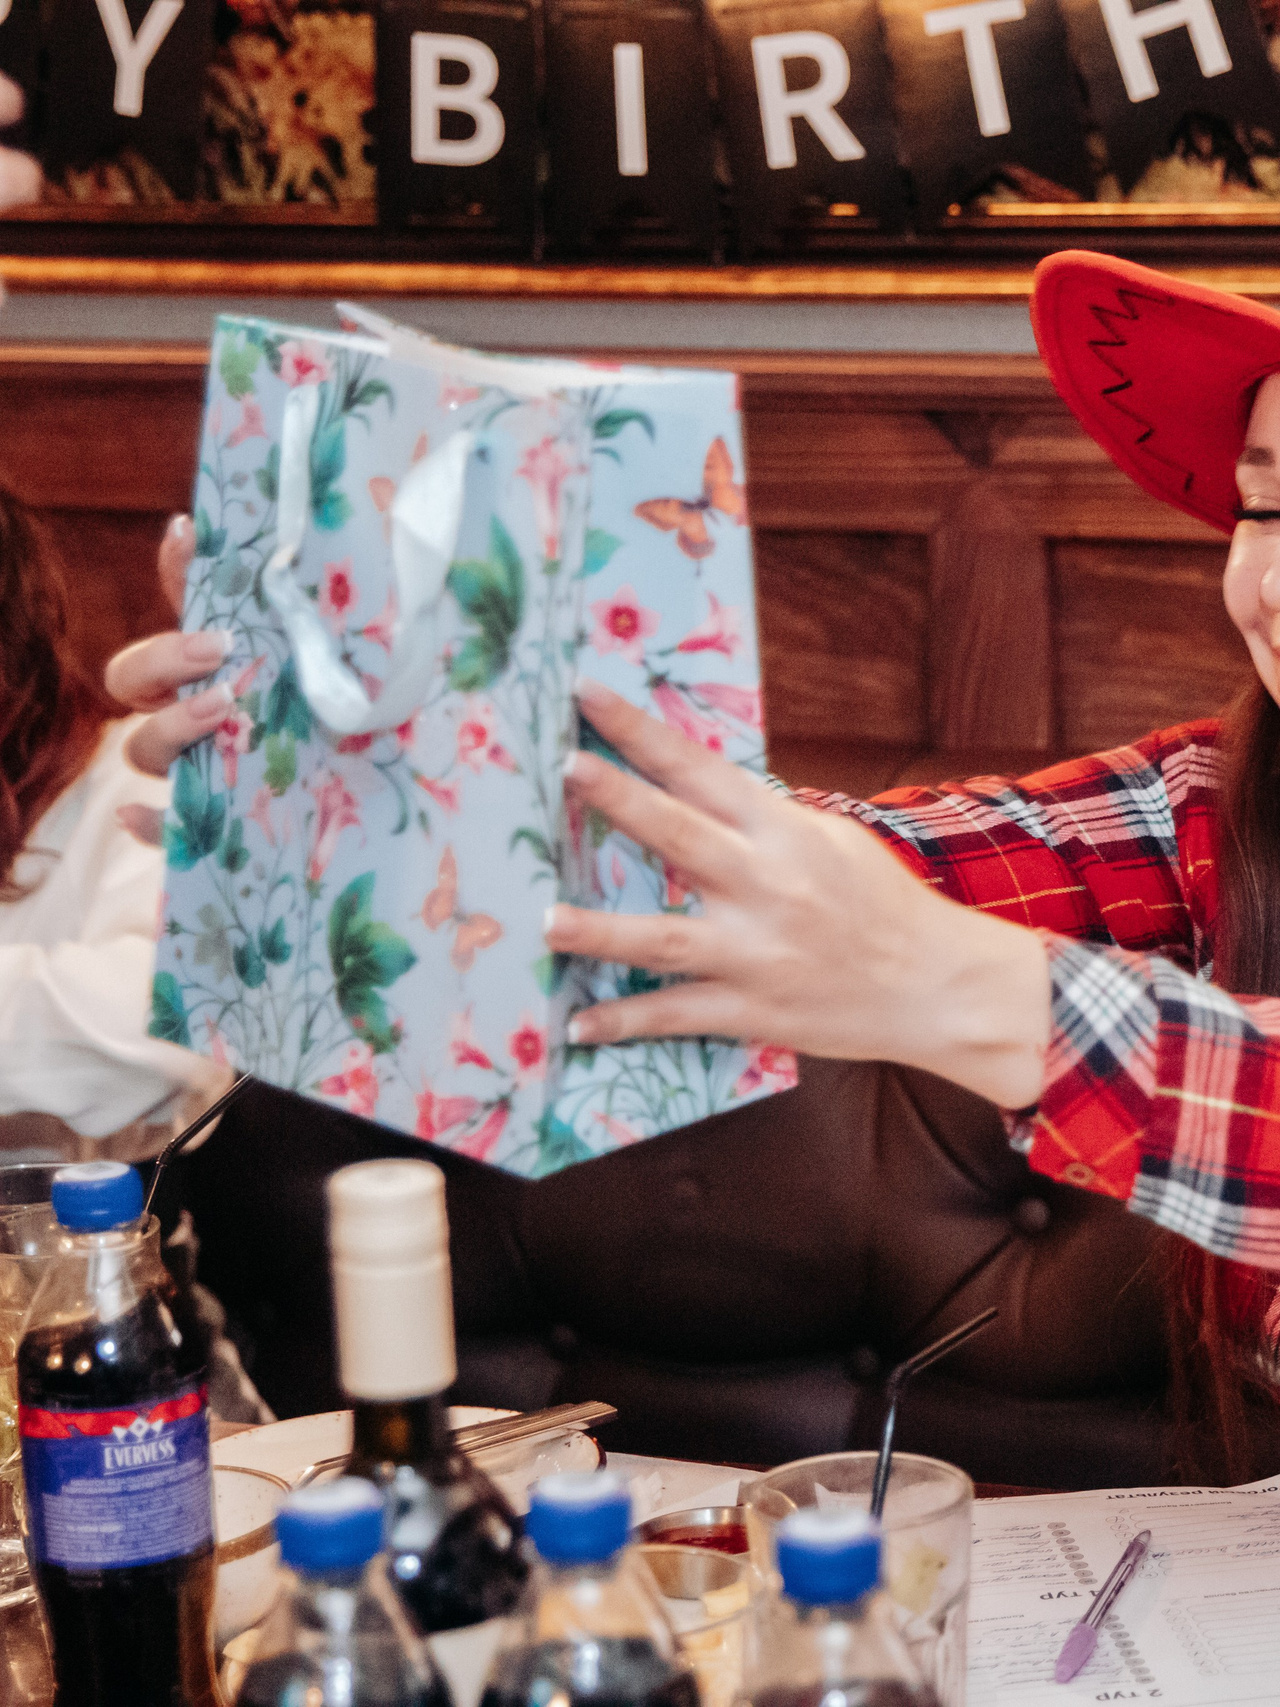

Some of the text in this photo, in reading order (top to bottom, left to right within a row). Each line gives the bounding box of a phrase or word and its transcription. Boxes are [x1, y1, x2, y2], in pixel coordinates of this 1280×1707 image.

[103, 1439, 177, 1470] EVERVESS
[1106, 1489, 1203, 1499] результат
[1039, 1590, 1082, 1599] тур
[1095, 1688, 1162, 1700] 2 тур
